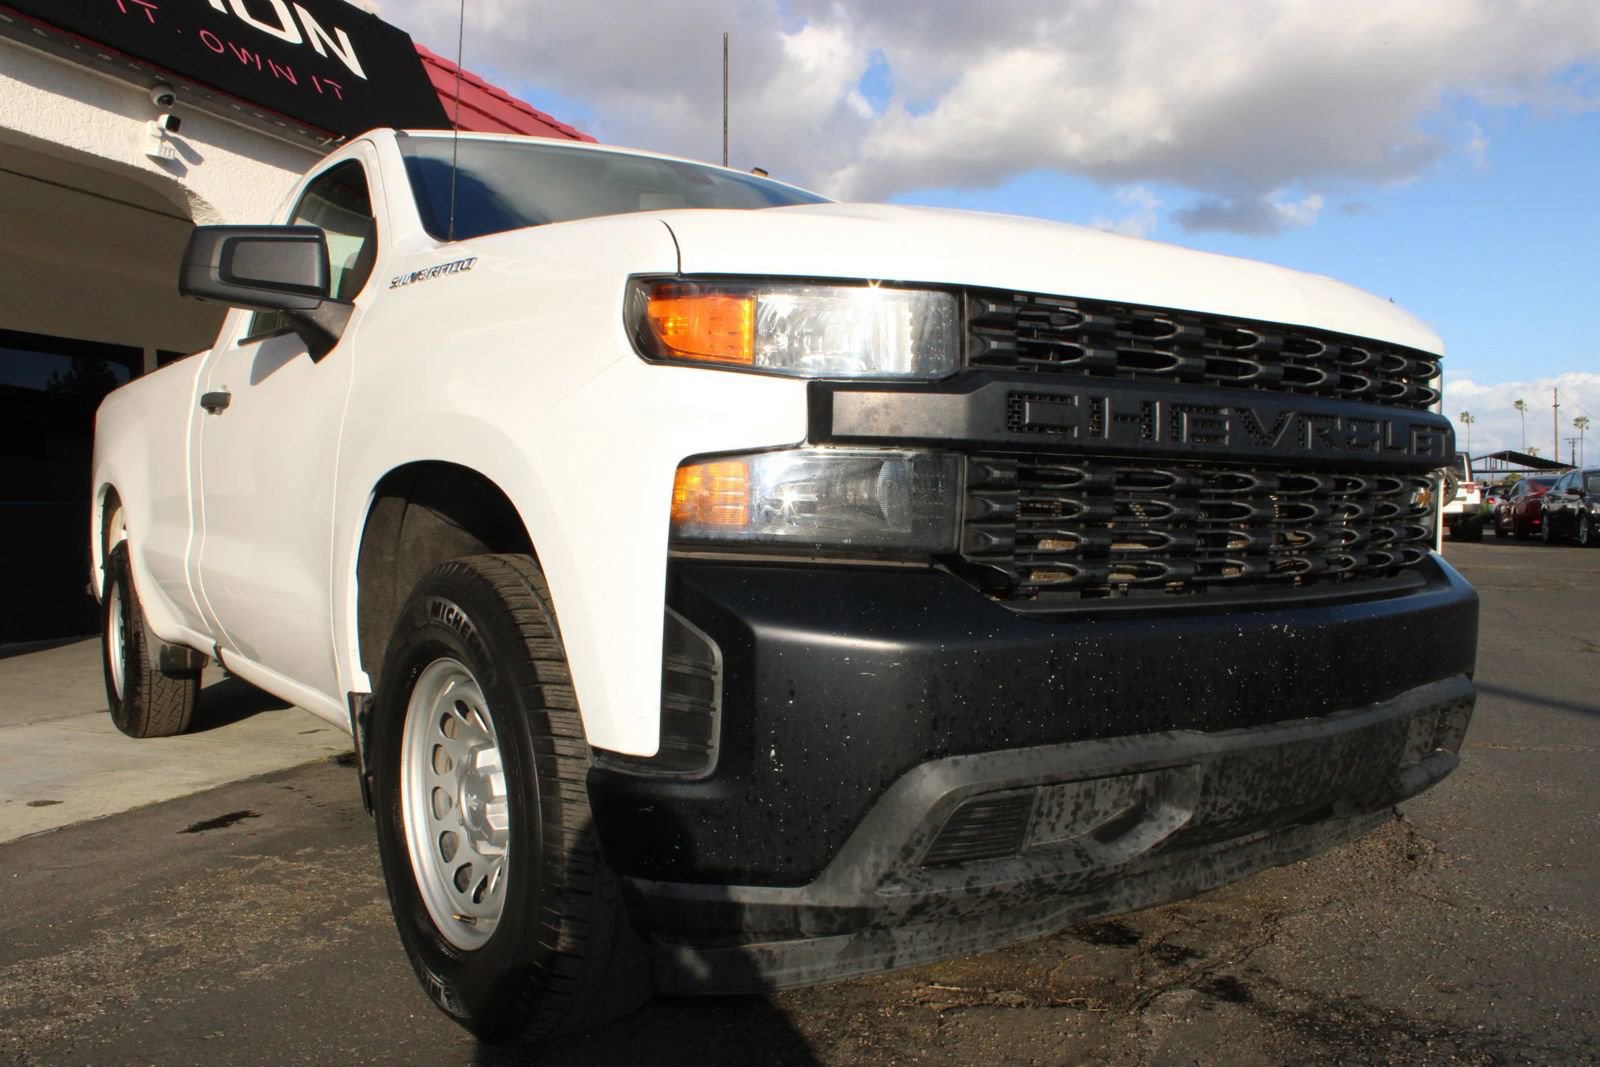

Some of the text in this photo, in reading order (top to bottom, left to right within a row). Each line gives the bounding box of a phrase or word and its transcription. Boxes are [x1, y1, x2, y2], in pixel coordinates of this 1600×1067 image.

[200, 30, 298, 86] OWN
[311, 75, 342, 100] IT
[209, 0, 368, 80] ON
[389, 257, 478, 290] SILVERADO
[1007, 389, 1452, 457] CHEVROLET
